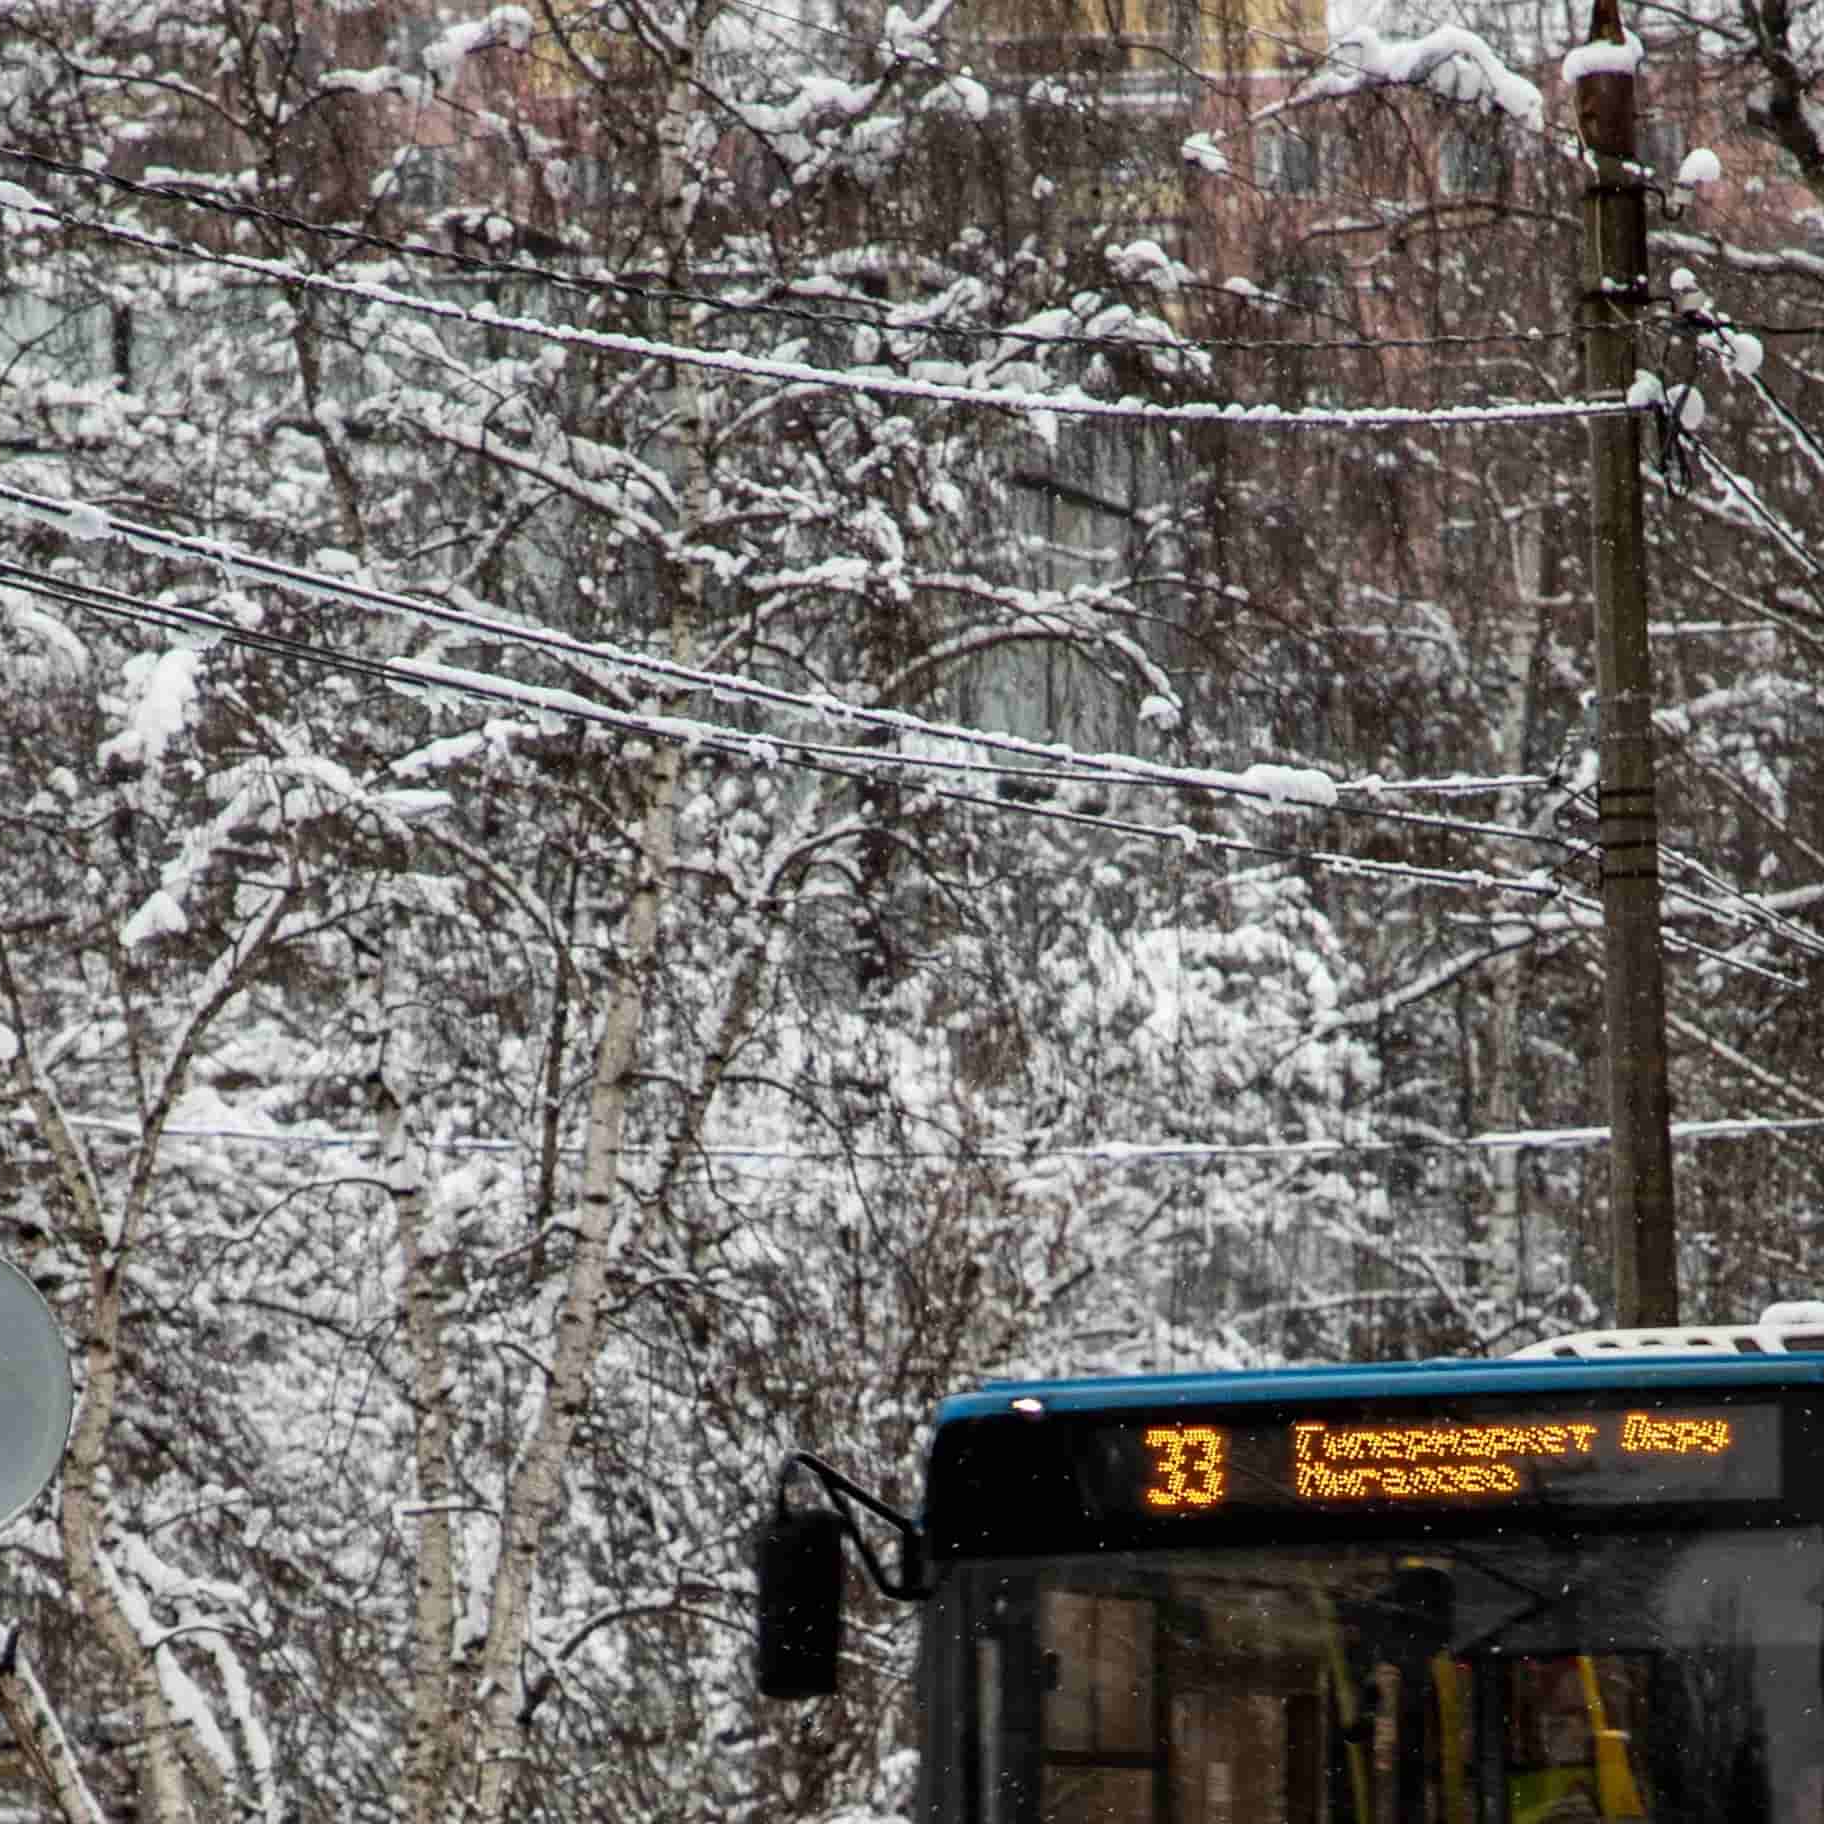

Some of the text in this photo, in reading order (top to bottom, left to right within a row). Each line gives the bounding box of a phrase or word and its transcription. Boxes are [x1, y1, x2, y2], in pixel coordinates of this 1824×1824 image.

[1295, 1422, 1598, 1460] Гипермаркет
[1145, 1427, 1224, 1504] 33
[1295, 1460, 1519, 1497] Мигалово
